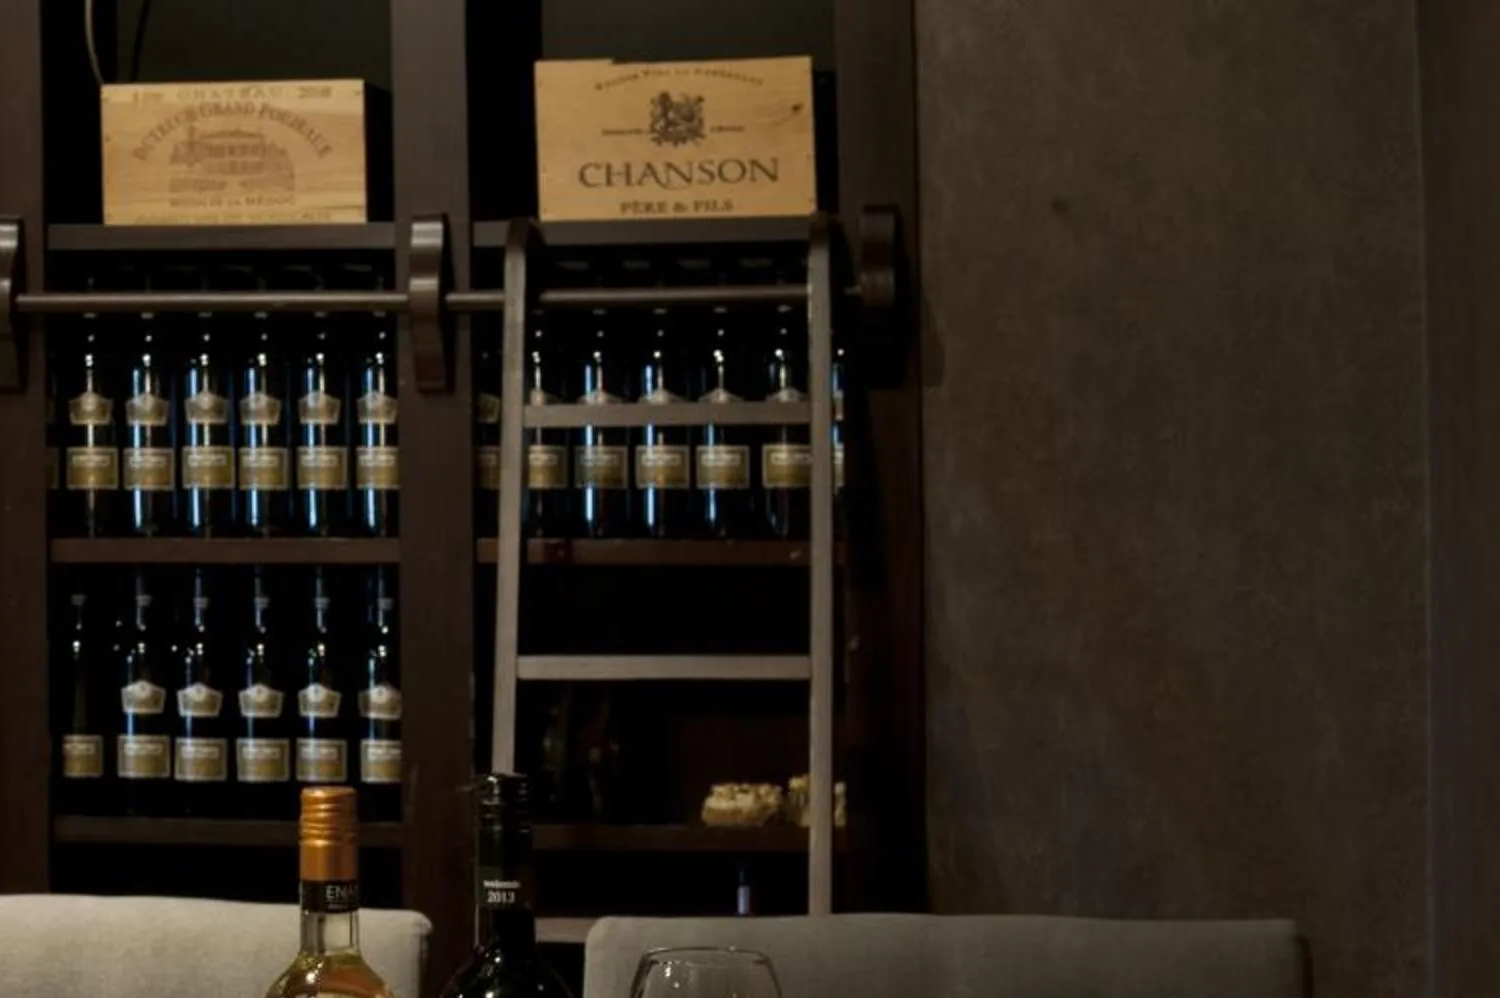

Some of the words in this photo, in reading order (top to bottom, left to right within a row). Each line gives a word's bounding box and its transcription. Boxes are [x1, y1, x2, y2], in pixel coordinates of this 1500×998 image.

[578, 157, 780, 189] CHANSON
[672, 201, 689, 214] &
[693, 198, 734, 213] FILS
